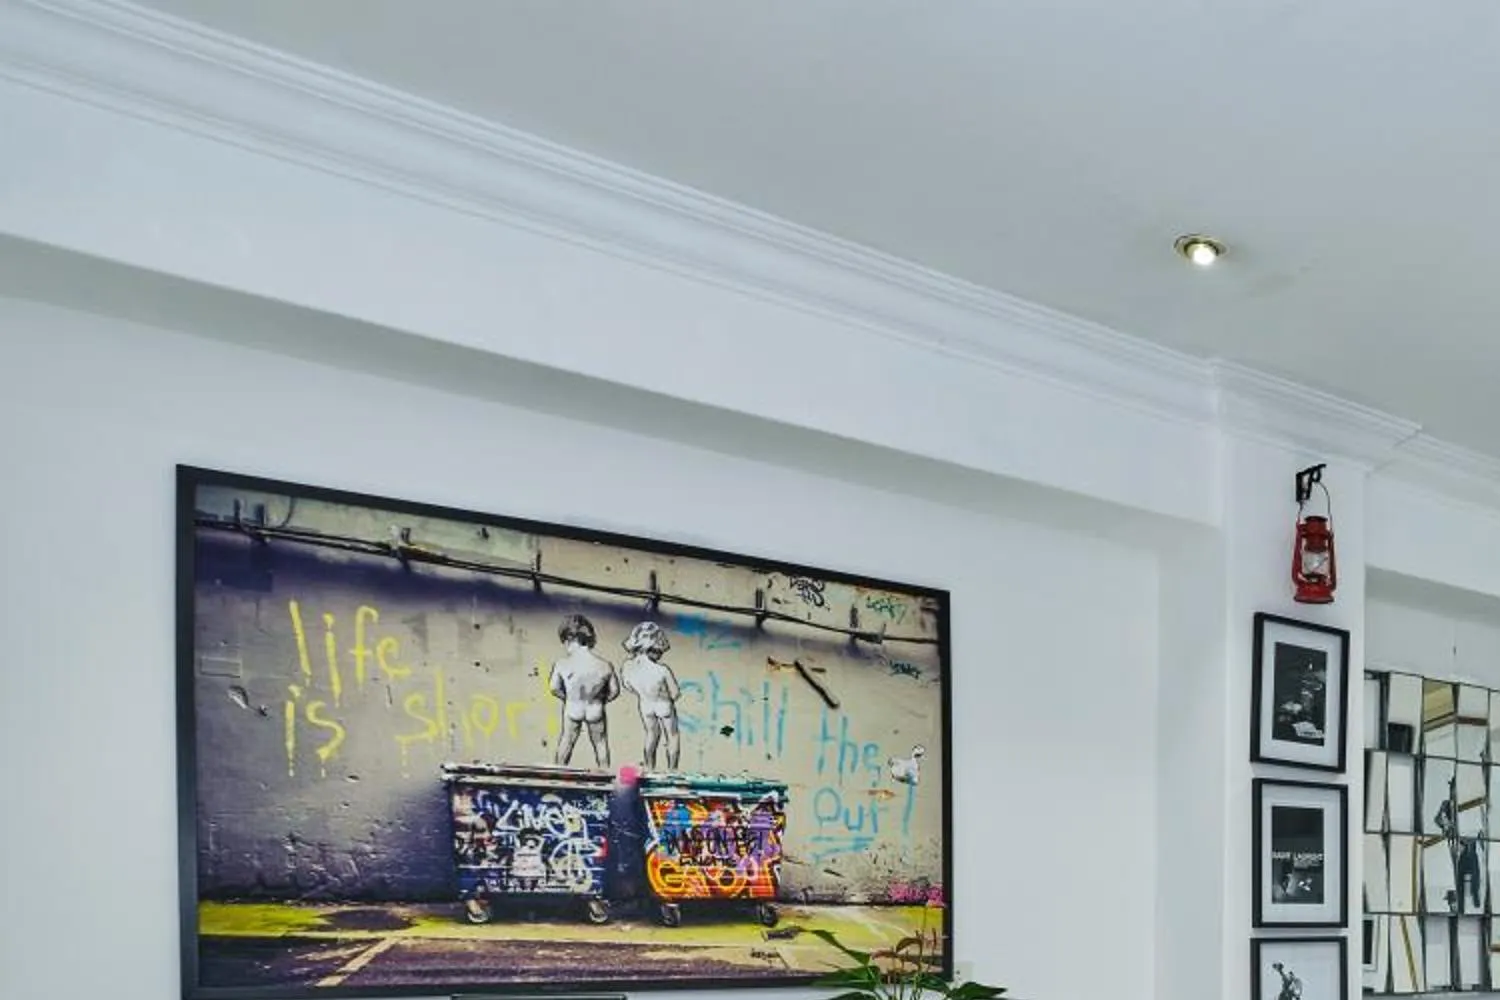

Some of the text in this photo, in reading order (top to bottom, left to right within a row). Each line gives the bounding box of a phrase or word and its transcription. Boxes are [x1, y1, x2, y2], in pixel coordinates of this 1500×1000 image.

[289, 599, 411, 707] life
[284, 684, 346, 778] is
[811, 703, 881, 785] the
